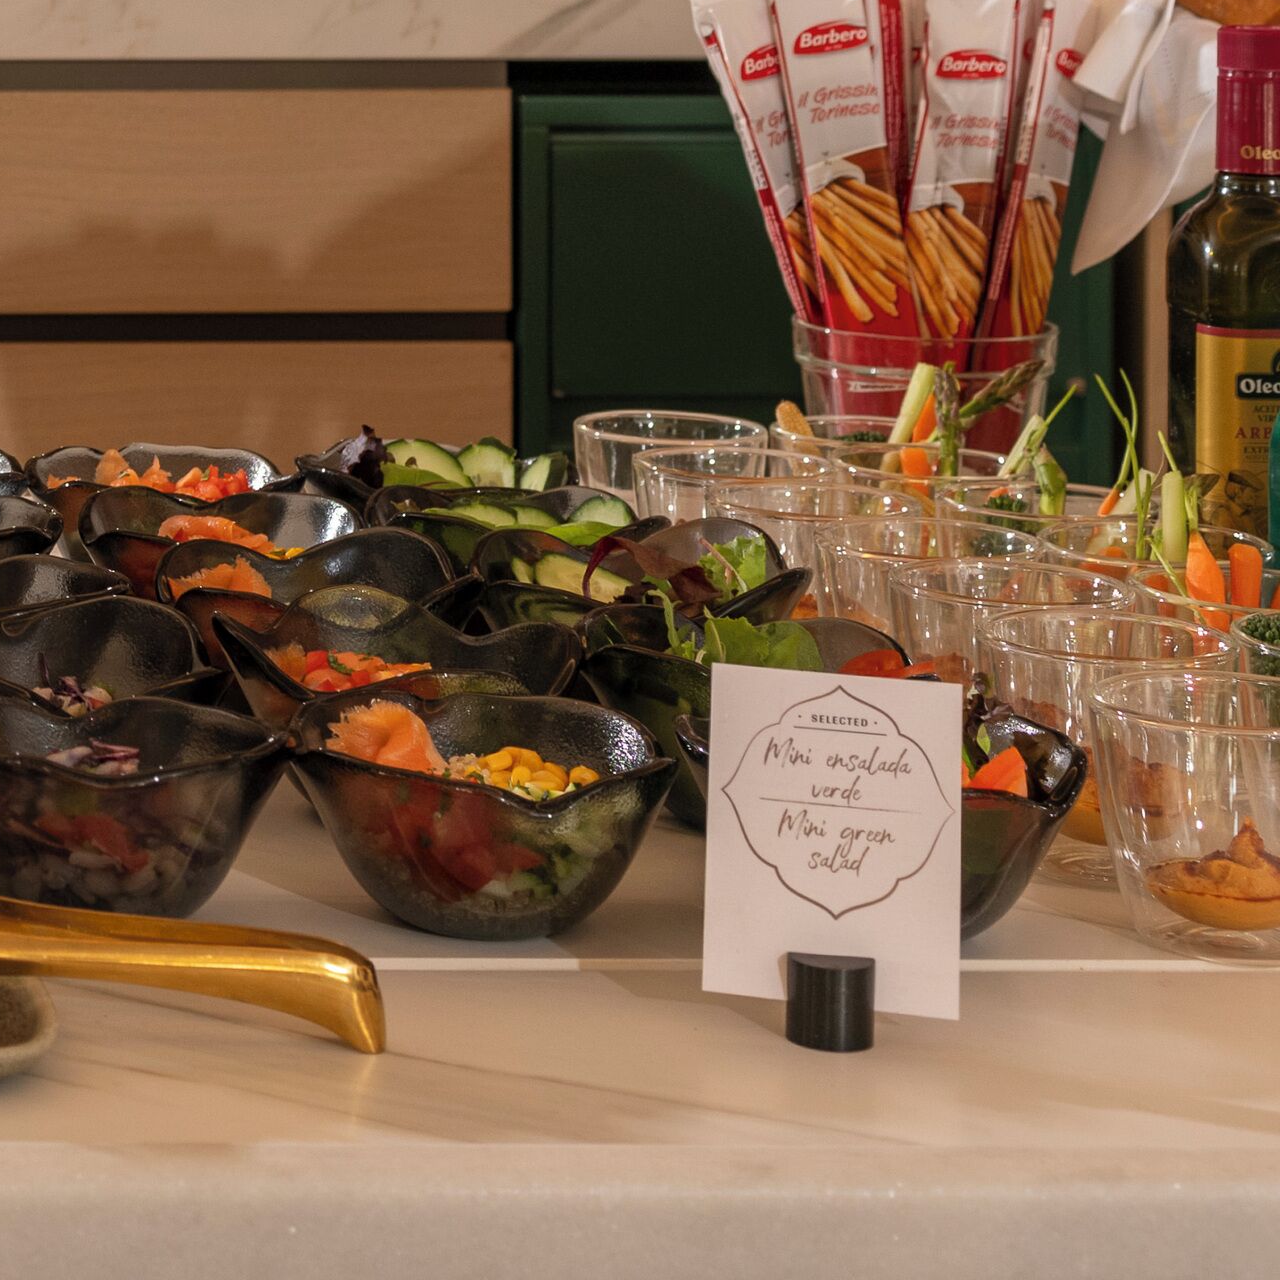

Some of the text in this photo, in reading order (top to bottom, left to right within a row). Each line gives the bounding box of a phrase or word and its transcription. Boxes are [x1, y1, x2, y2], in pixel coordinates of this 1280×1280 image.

[799, 28, 868, 49] Barbero
[941, 56, 1007, 73] Barbero
[810, 712, 869, 728] SELECTED
[763, 736, 912, 778] Mini ensalada
[811, 775, 862, 806] verde
[777, 807, 896, 860] Mini green
[807, 846, 870, 878] salad
